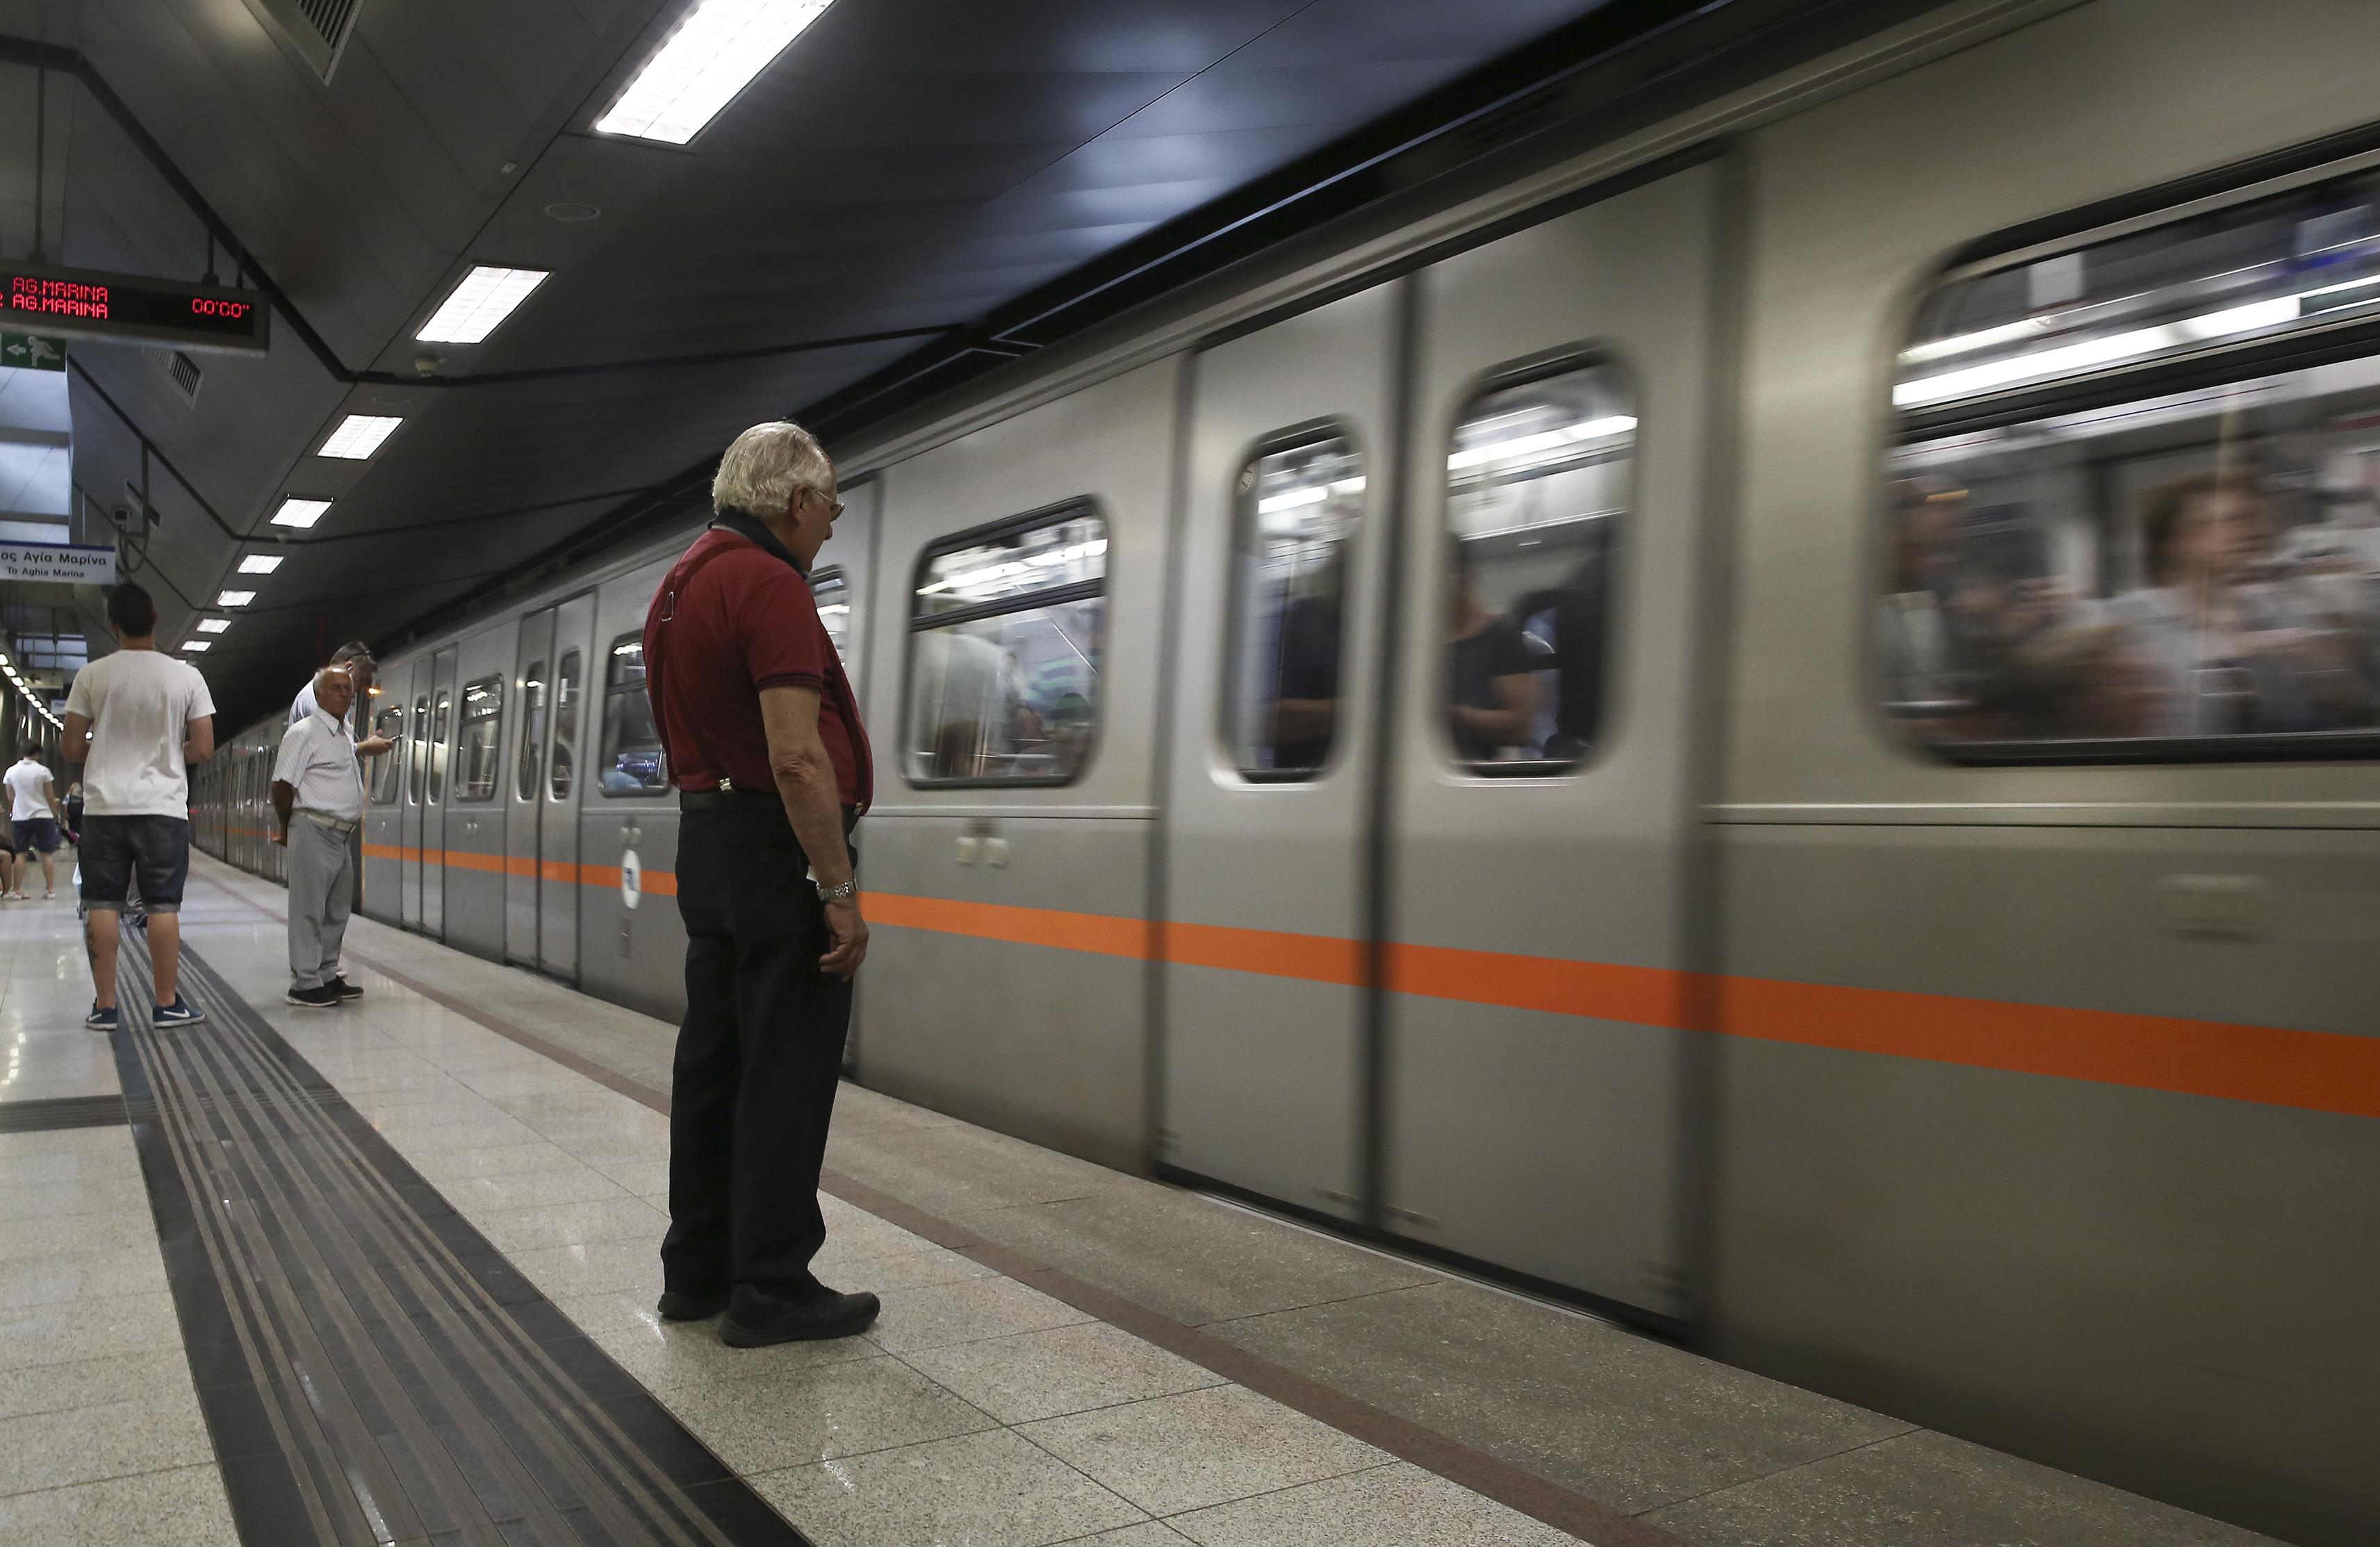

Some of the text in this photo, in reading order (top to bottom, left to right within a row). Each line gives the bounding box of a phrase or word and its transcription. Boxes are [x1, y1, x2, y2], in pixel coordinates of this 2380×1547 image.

[13, 277, 108, 302] AG.MARINA
[13, 293, 108, 320] AG.MARINA
[23, 551, 52, 564] Αγία
[59, 553, 106, 566] Μαρίνα
[22, 567, 49, 576] Aghia
[53, 569, 84, 578] Marina
